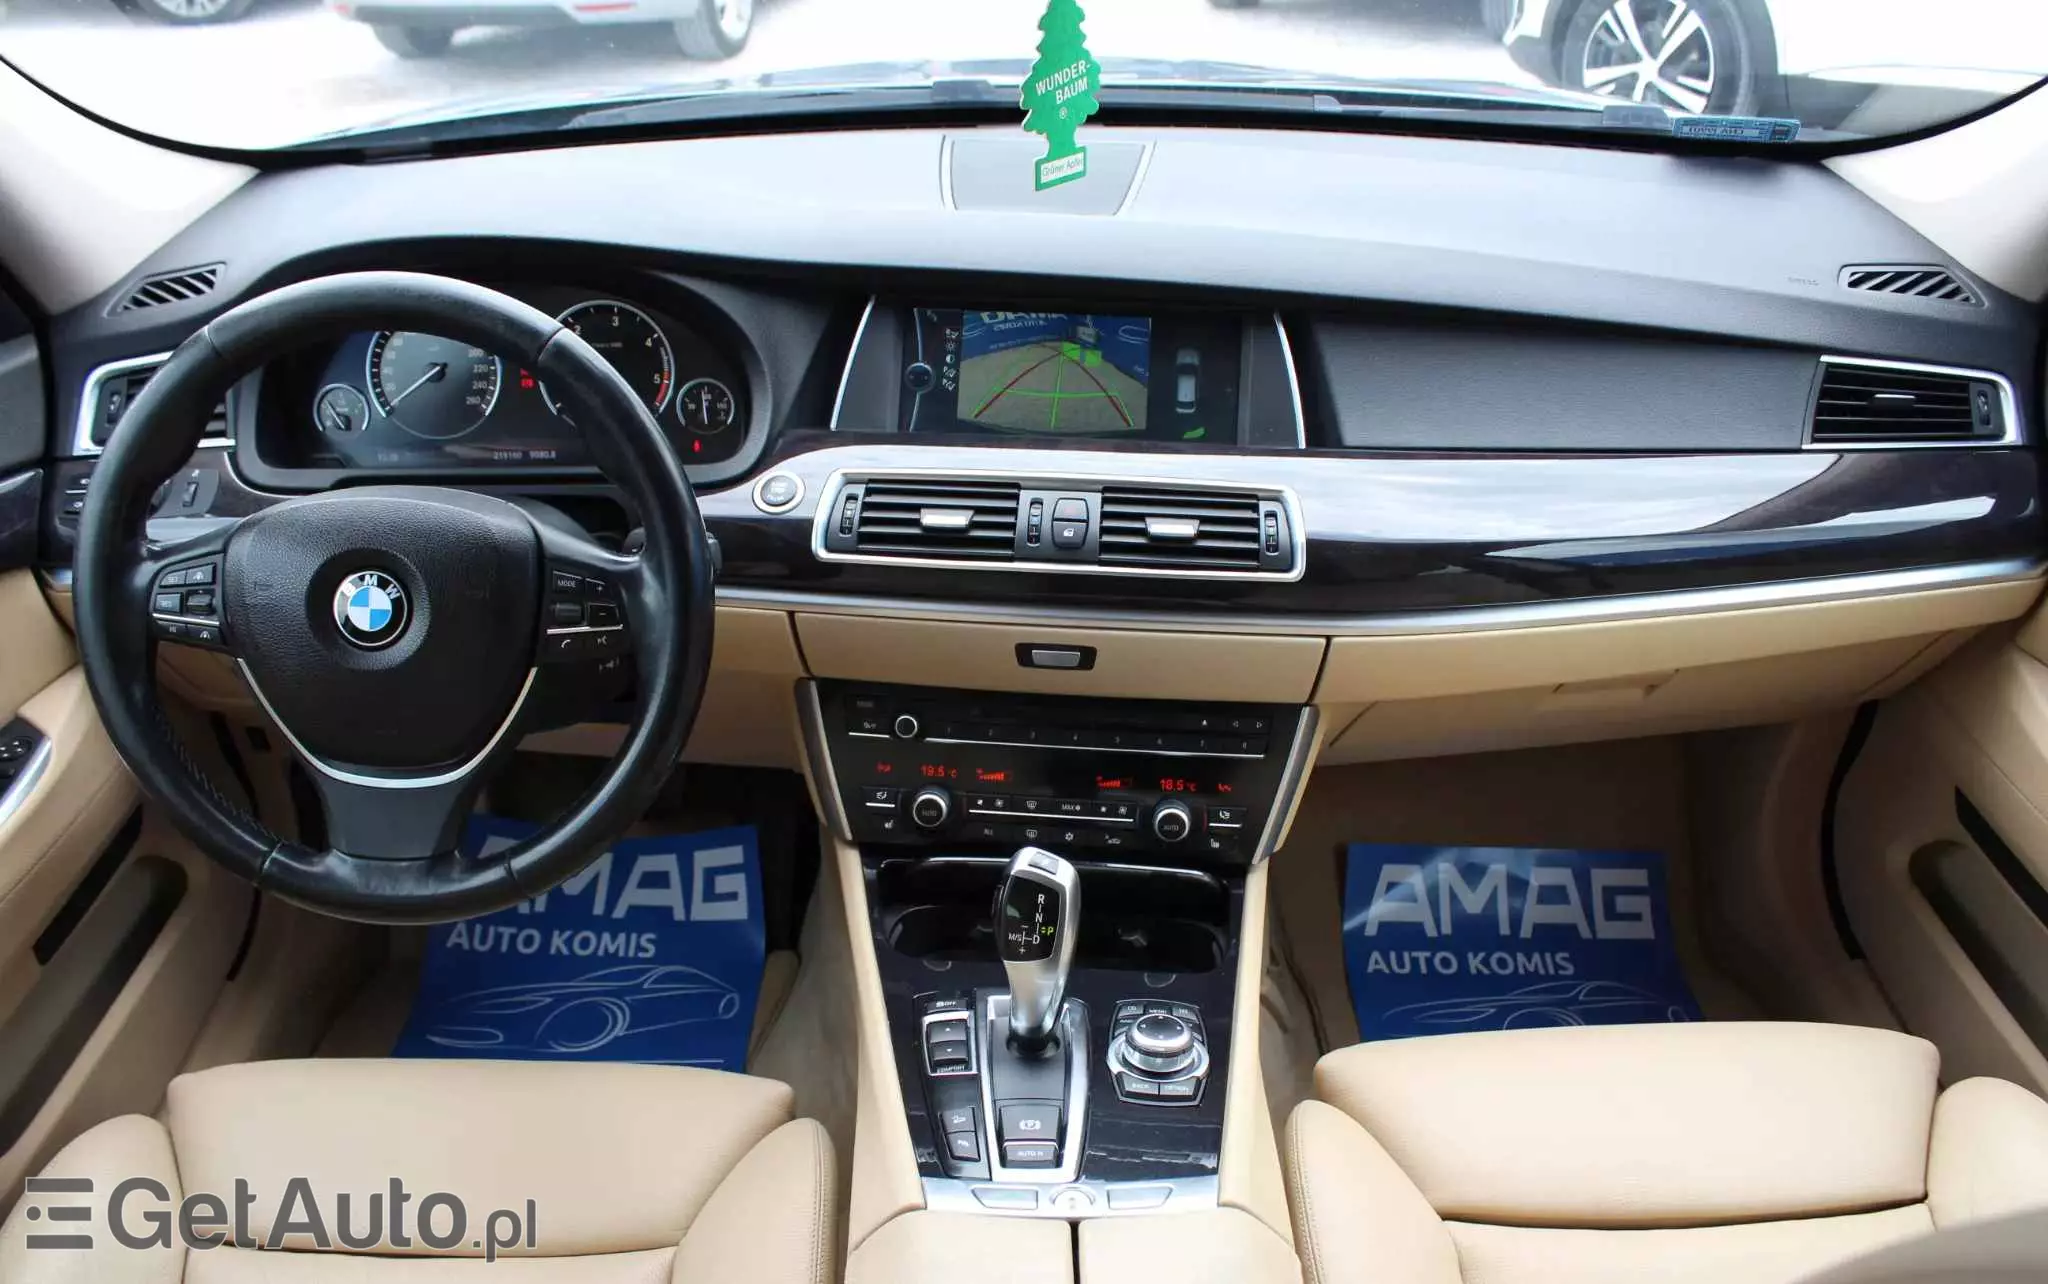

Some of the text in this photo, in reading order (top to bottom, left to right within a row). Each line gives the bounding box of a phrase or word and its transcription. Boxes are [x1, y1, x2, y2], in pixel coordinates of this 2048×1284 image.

[1035, 60, 1091, 96] WUNDER-
[1055, 76, 1089, 104] BAUM
[612, 316, 619, 327] 3
[645, 337, 652, 347] 4
[653, 375, 661, 385] 5
[343, 574, 401, 600] BMW
[557, 579, 577, 588] MODE
[920, 765, 945, 777] 19.5
[1160, 779, 1184, 791] 18.5
[1037, 893, 1045, 905] R
[1364, 862, 1655, 940] AMAG
[1035, 912, 1043, 923] N
[1047, 926, 1054, 936] P
[446, 921, 657, 958] AUTO KOMIS
[1032, 934, 1040, 945] D
[1367, 951, 1575, 976] AUTO KOMIS
[1017, 1149, 1036, 1157] AUTO
